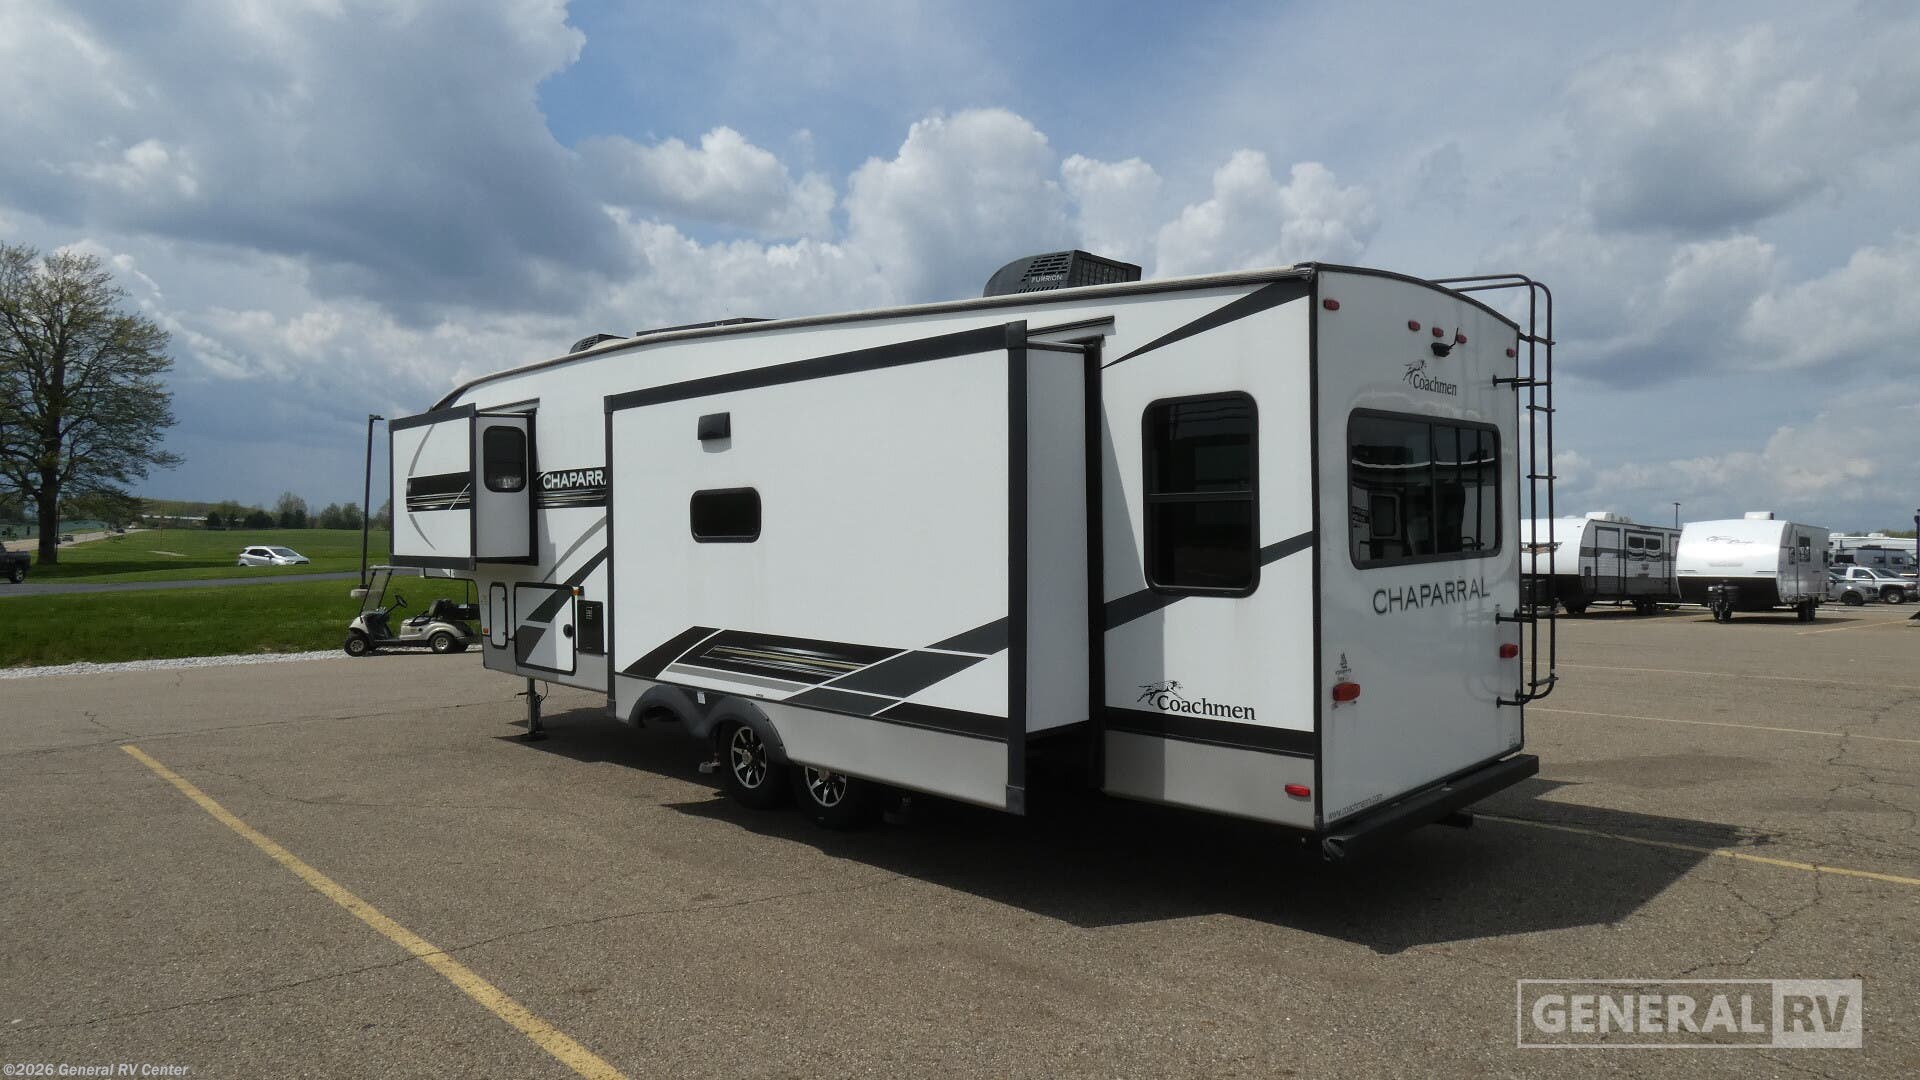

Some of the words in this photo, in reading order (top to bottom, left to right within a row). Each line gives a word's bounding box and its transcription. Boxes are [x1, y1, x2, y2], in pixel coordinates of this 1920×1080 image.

[1413, 373, 1457, 396] Coachmen
[543, 469, 607, 490] CHAPARR
[1372, 576, 1490, 614] CHAPARRAL
[1157, 695, 1257, 721] Coachmen
